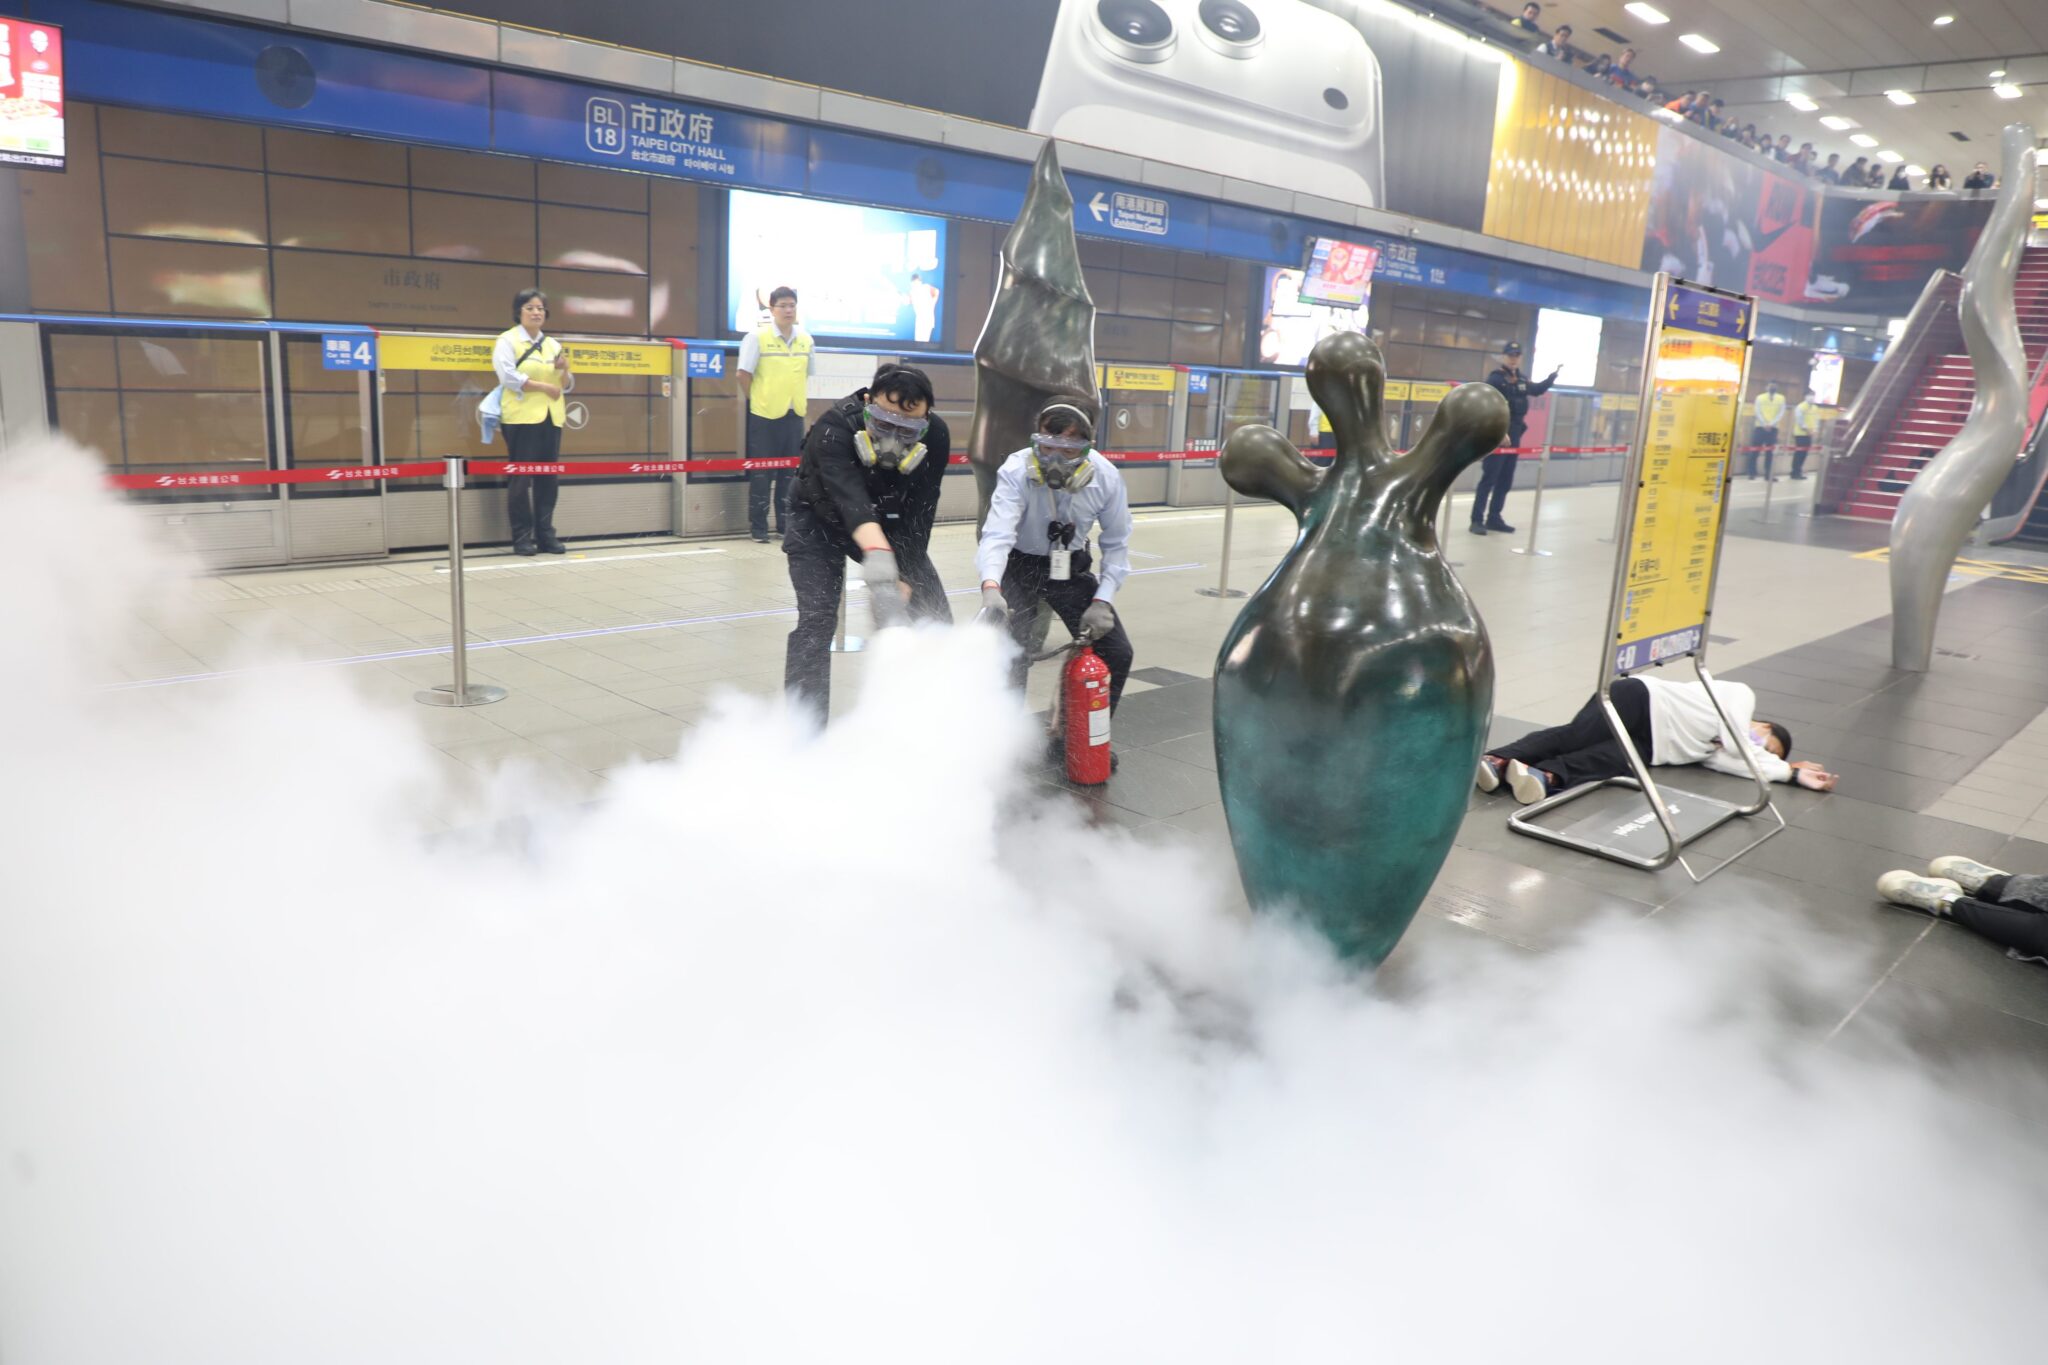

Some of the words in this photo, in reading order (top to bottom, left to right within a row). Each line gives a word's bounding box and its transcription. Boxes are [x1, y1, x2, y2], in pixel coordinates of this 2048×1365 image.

[593, 105, 619, 126] BL
[630, 102, 714, 144] 市政府
[594, 127, 617, 146] 18
[631, 135, 668, 151] TAIPEI
[670, 141, 697, 155] CITY
[697, 146, 726, 160] HALL
[631, 150, 675, 166] 台北市政府
[383, 268, 441, 290] 市政府
[353, 341, 372, 365] 4
[709, 354, 722, 373] 4
[1200, 375, 1207, 390] 4
[177, 475, 240, 485] 台北捷運公司
